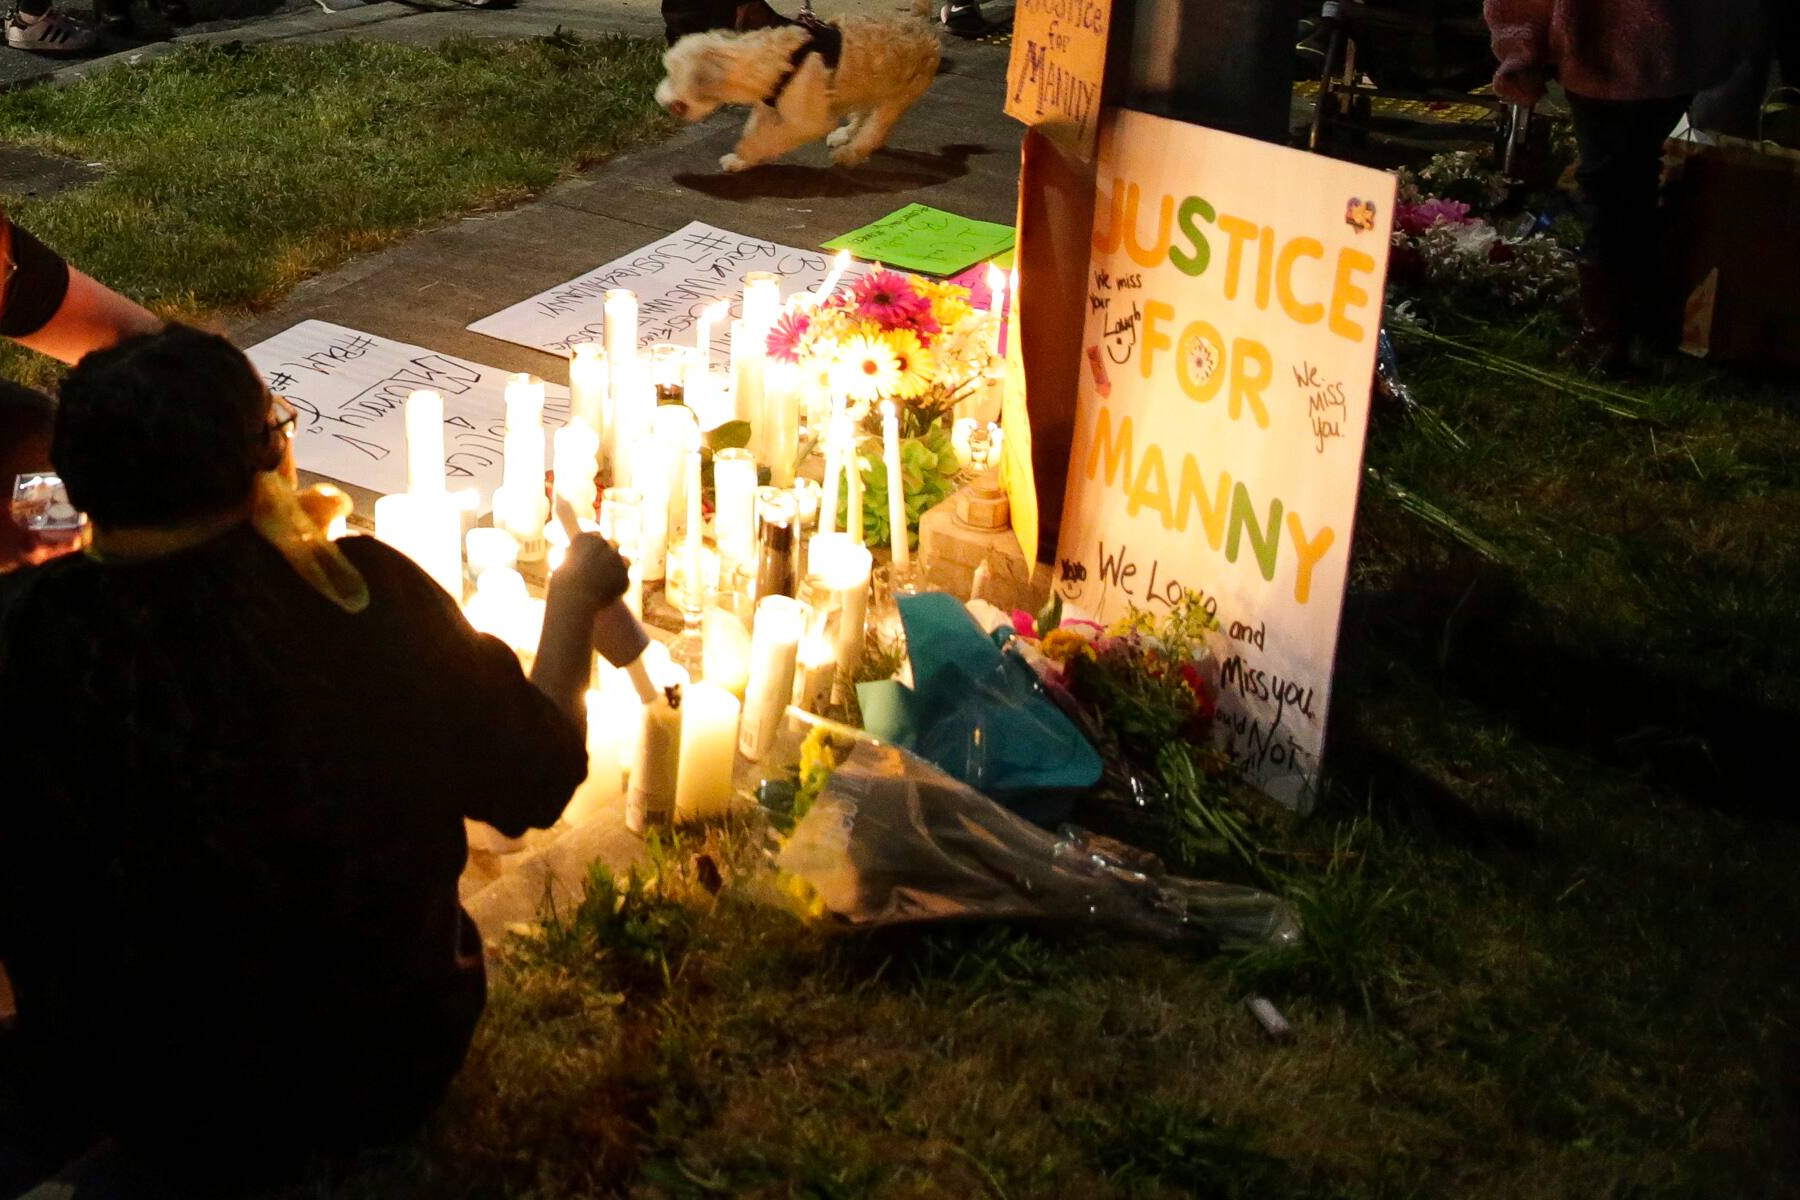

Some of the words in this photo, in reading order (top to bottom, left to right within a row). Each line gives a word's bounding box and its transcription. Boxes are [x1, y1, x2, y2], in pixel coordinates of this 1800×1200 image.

[1091, 177, 1375, 342] JUSTICE
[1116, 273, 1142, 291] miss
[1139, 300, 1274, 430] FOR
[1086, 406, 1336, 605] MANNY
[1098, 541, 1136, 595] We
[1229, 620, 1266, 652] and
[1221, 655, 1269, 701] Miss
